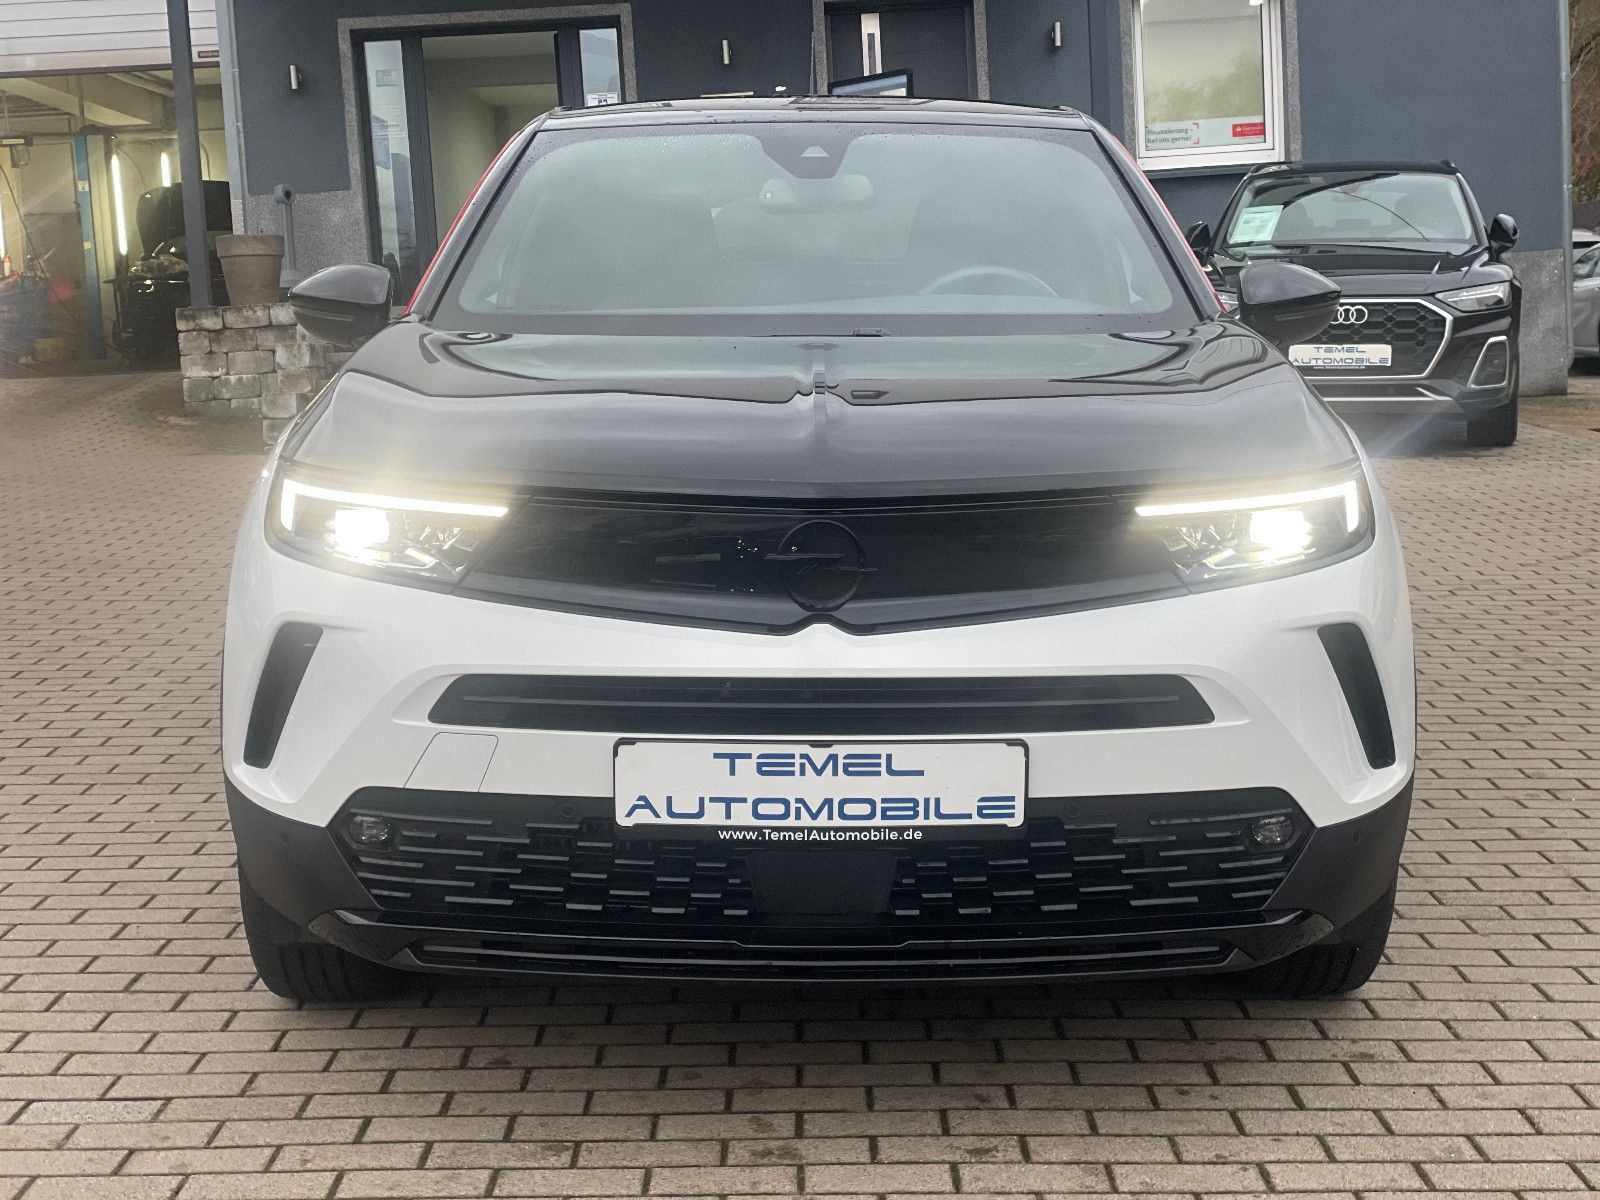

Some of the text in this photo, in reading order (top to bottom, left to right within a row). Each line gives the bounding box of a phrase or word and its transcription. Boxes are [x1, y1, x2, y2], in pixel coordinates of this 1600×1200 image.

[713, 752, 925, 777] TEMEL
[624, 795, 1016, 821] AUTOMOBILE
[718, 828, 923, 841] www.TemelAutomobile.de
